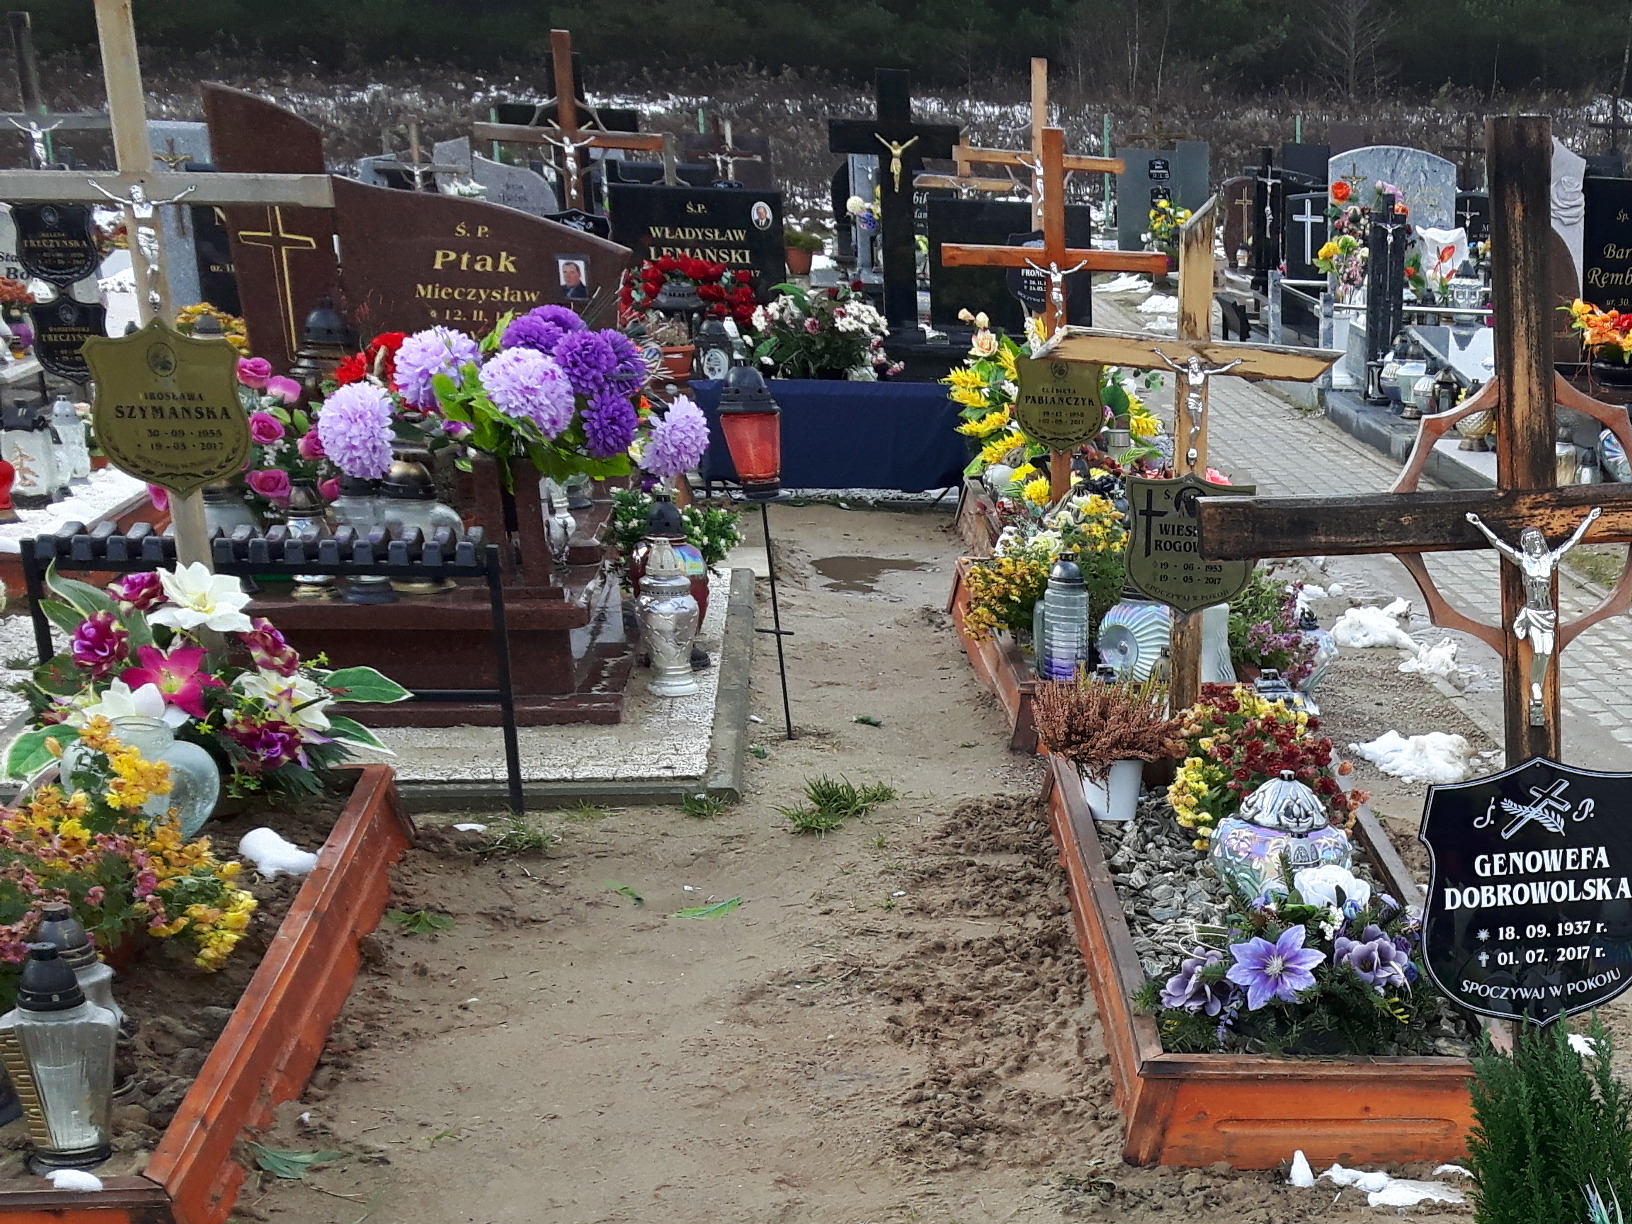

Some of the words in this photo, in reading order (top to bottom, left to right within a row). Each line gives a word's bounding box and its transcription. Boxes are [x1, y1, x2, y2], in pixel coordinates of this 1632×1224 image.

[455, 222, 470, 237] Ś.
[477, 225, 490, 238] P.
[649, 226, 747, 242] WŁADYSŁAW
[433, 249, 518, 273] Ptak
[649, 246, 751, 265] LEMAŃSKI
[414, 283, 541, 305] Mieczysław
[1572, 797, 1596, 822] P.
[1474, 846, 1611, 877] GENOWEFA
[1556, 920, 1592, 937] 1937
[1556, 945, 1591, 962] 2017
[1460, 979, 1546, 1000] SPOCZYWAJ
[1548, 985, 1563, 998] W
[1566, 967, 1622, 996] POKOJU
